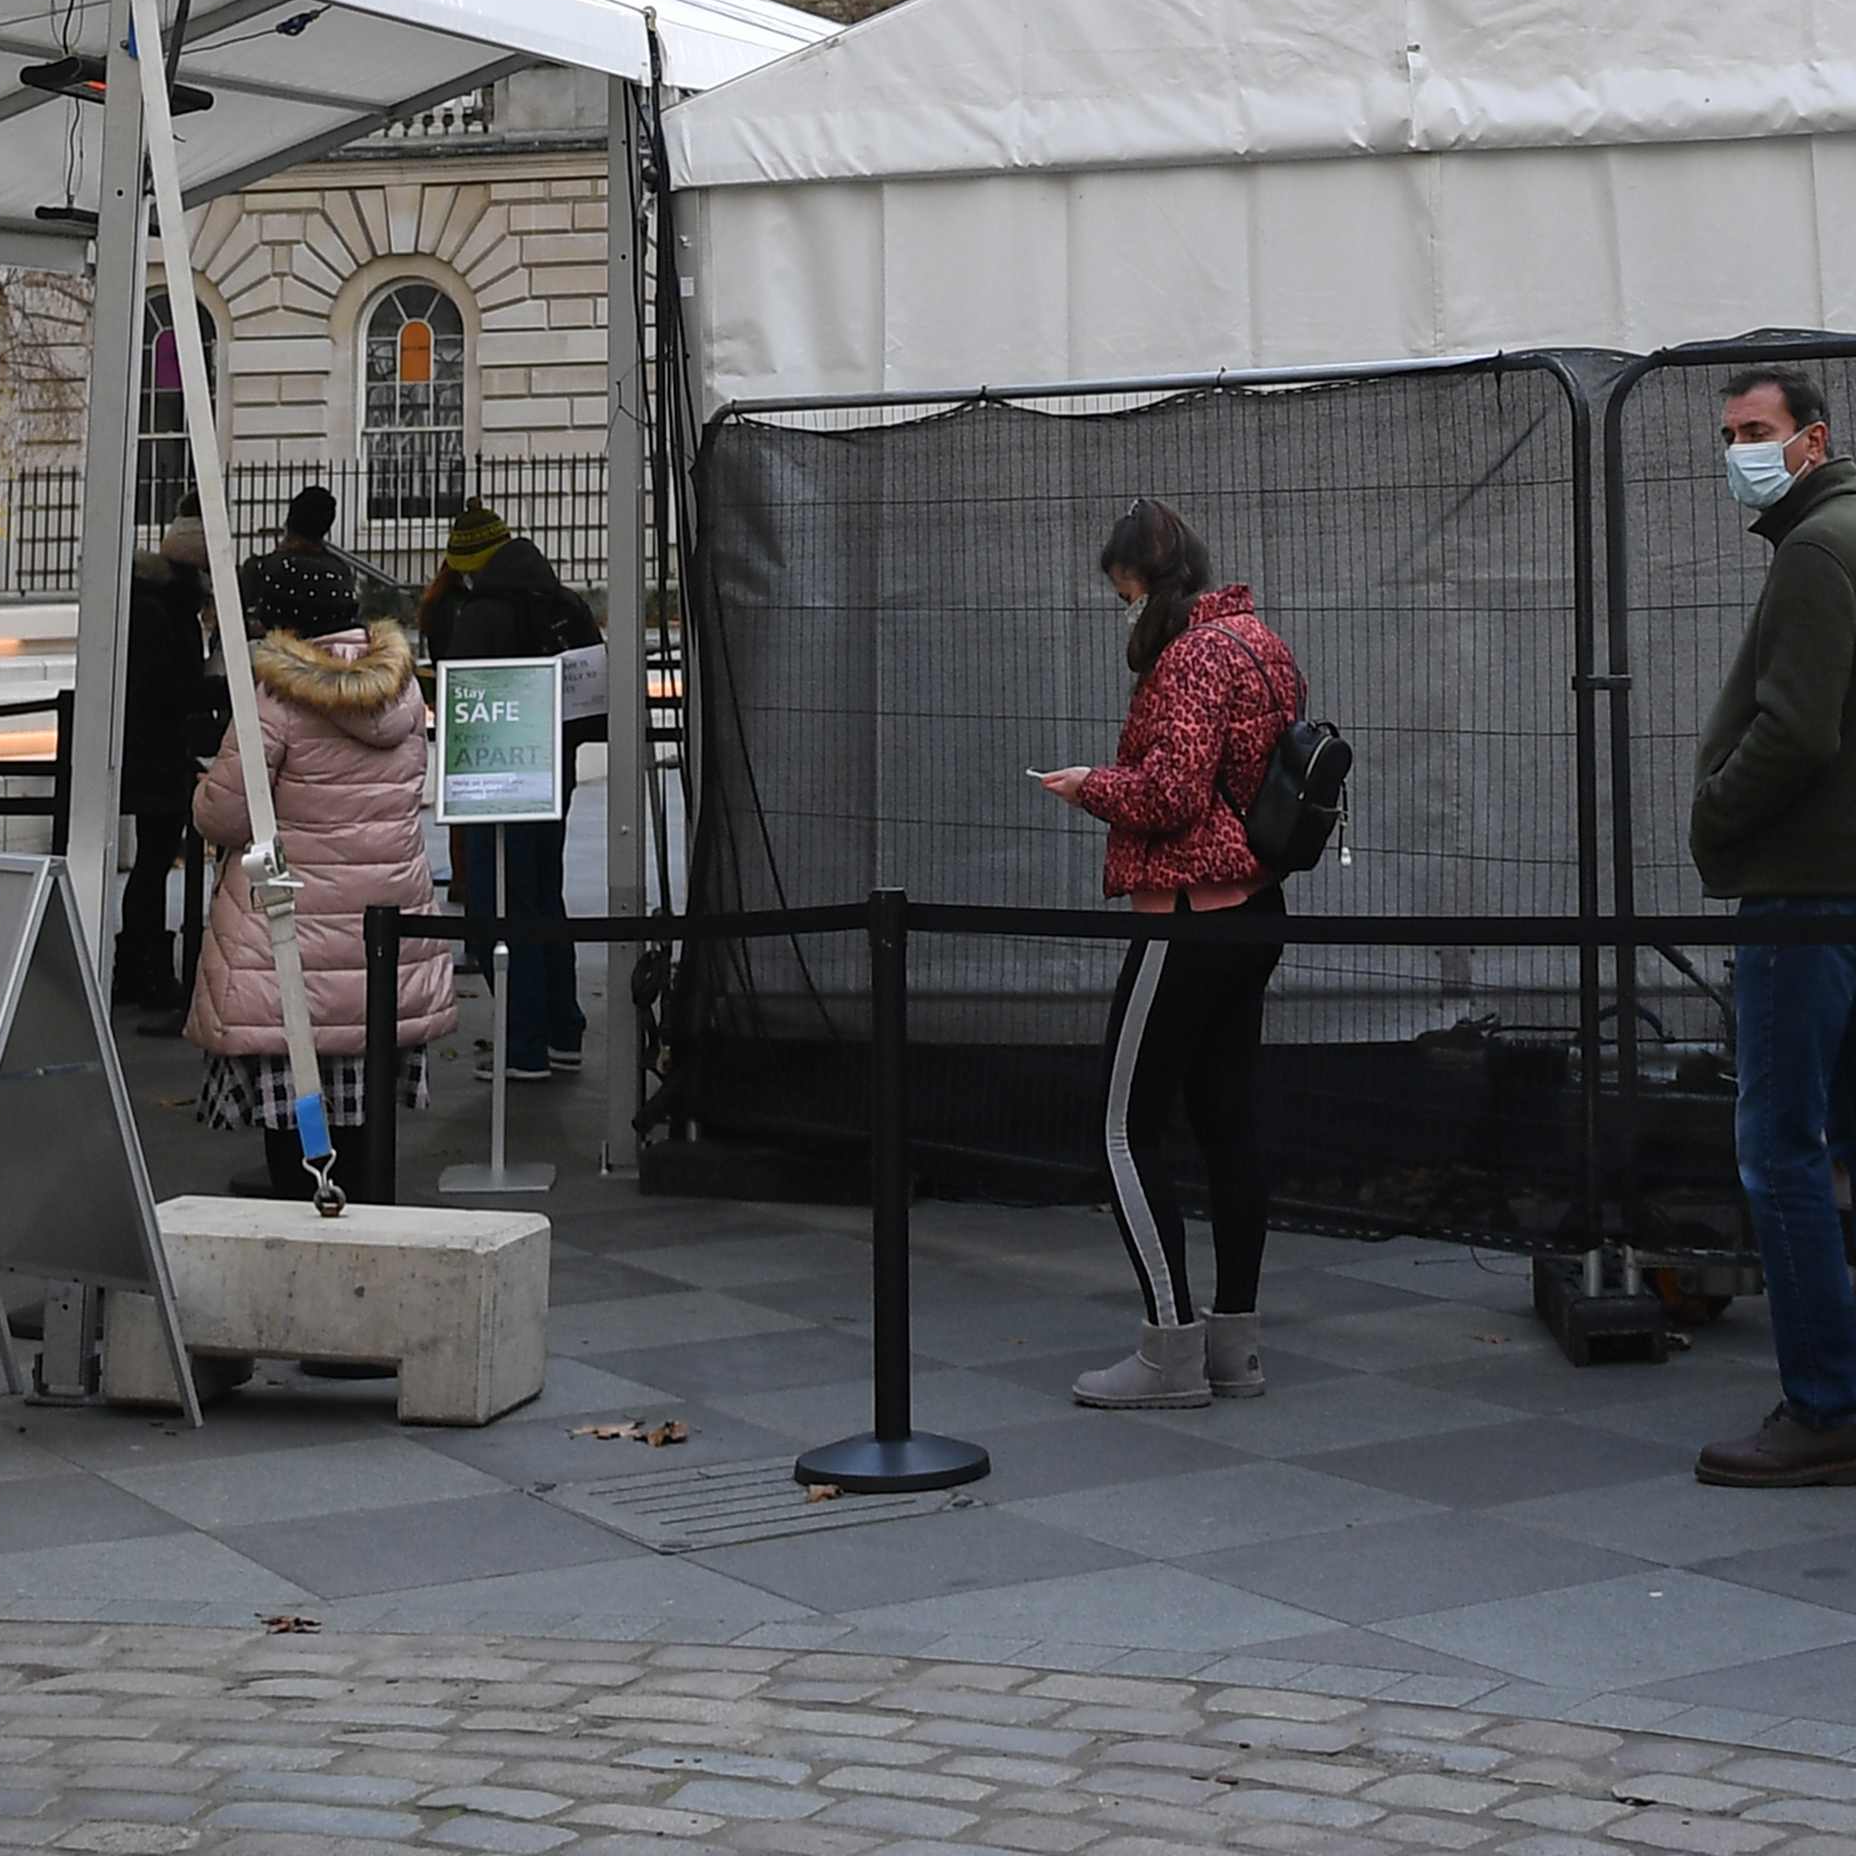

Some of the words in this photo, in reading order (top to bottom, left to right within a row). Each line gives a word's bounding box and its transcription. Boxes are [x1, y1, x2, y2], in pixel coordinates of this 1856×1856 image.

[454, 687, 486, 701] Stay
[454, 701, 520, 724] SAFE
[454, 746, 540, 767] APART
